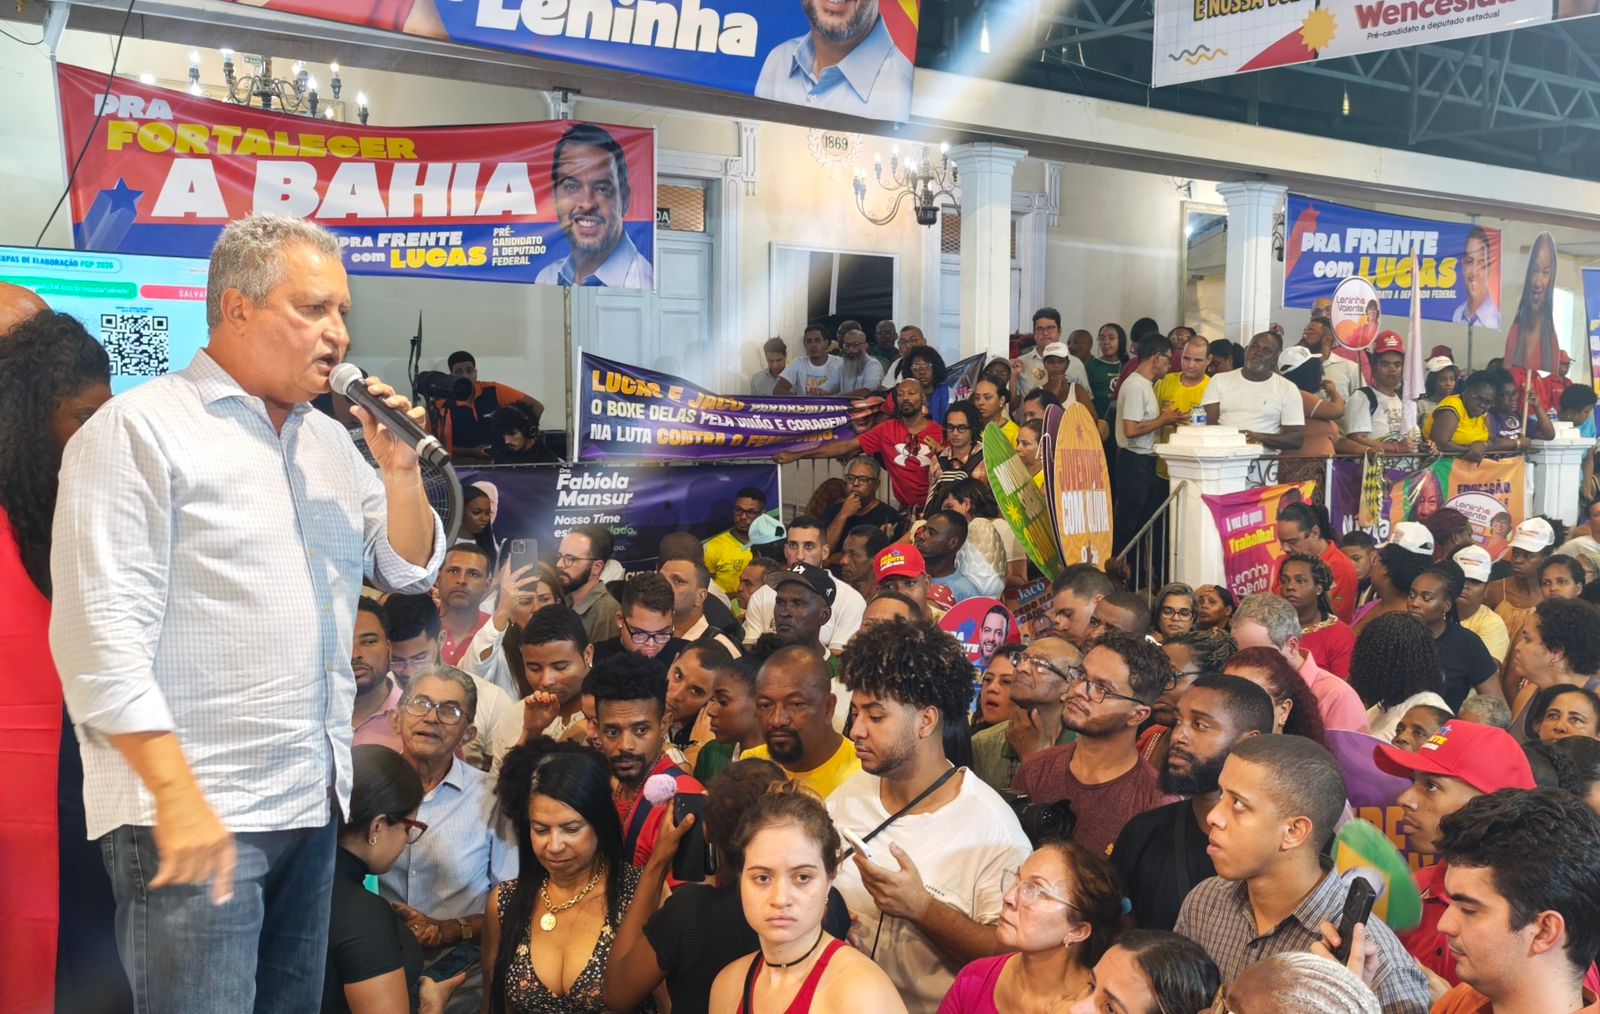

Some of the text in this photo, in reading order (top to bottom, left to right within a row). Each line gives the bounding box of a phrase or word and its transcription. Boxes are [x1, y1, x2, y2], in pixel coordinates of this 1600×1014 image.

[1354, 0, 1517, 29] Wencesl
[1367, 24, 1419, 40] Pré-candidato
[1427, 16, 1465, 30] deputado
[1466, 9, 1500, 23] estadual
[94, 93, 173, 120] PRA
[107, 120, 418, 159] FORTALECER
[825, 135, 848, 150] 1869
[150, 158, 537, 219] A BAHIA
[338, 231, 463, 248] PRA FRENTE
[493, 225, 516, 237] PRÉ-
[493, 235, 543, 247] CANDIDATO
[1301, 227, 1439, 256] PRA FRENTE
[0, 255, 19, 263] APAS
[22, 256, 30, 264] DE
[351, 246, 487, 269] com LUCAS
[492, 245, 546, 256] A DEPUTADO
[492, 255, 531, 266] FEDERAL
[1313, 256, 1458, 289] com LUCAS
[179, 289, 208, 298] SALVA
[591, 399, 602, 415] O
[607, 400, 645, 419] BOXE
[649, 404, 697, 423] DELAS
[700, 411, 734, 427] PELA
[734, 414, 775, 430] UNIÃO
[774, 420, 786, 431] E
[590, 423, 611, 441] NA
[616, 426, 652, 444] LUTA
[656, 428, 726, 446] CONTRA
[556, 472, 629, 490] Fabíola
[557, 490, 634, 507] Mansur
[554, 513, 621, 525] Nosso Time
[554, 528, 572, 538] est
[1016, 579, 1045, 601] Jacó
